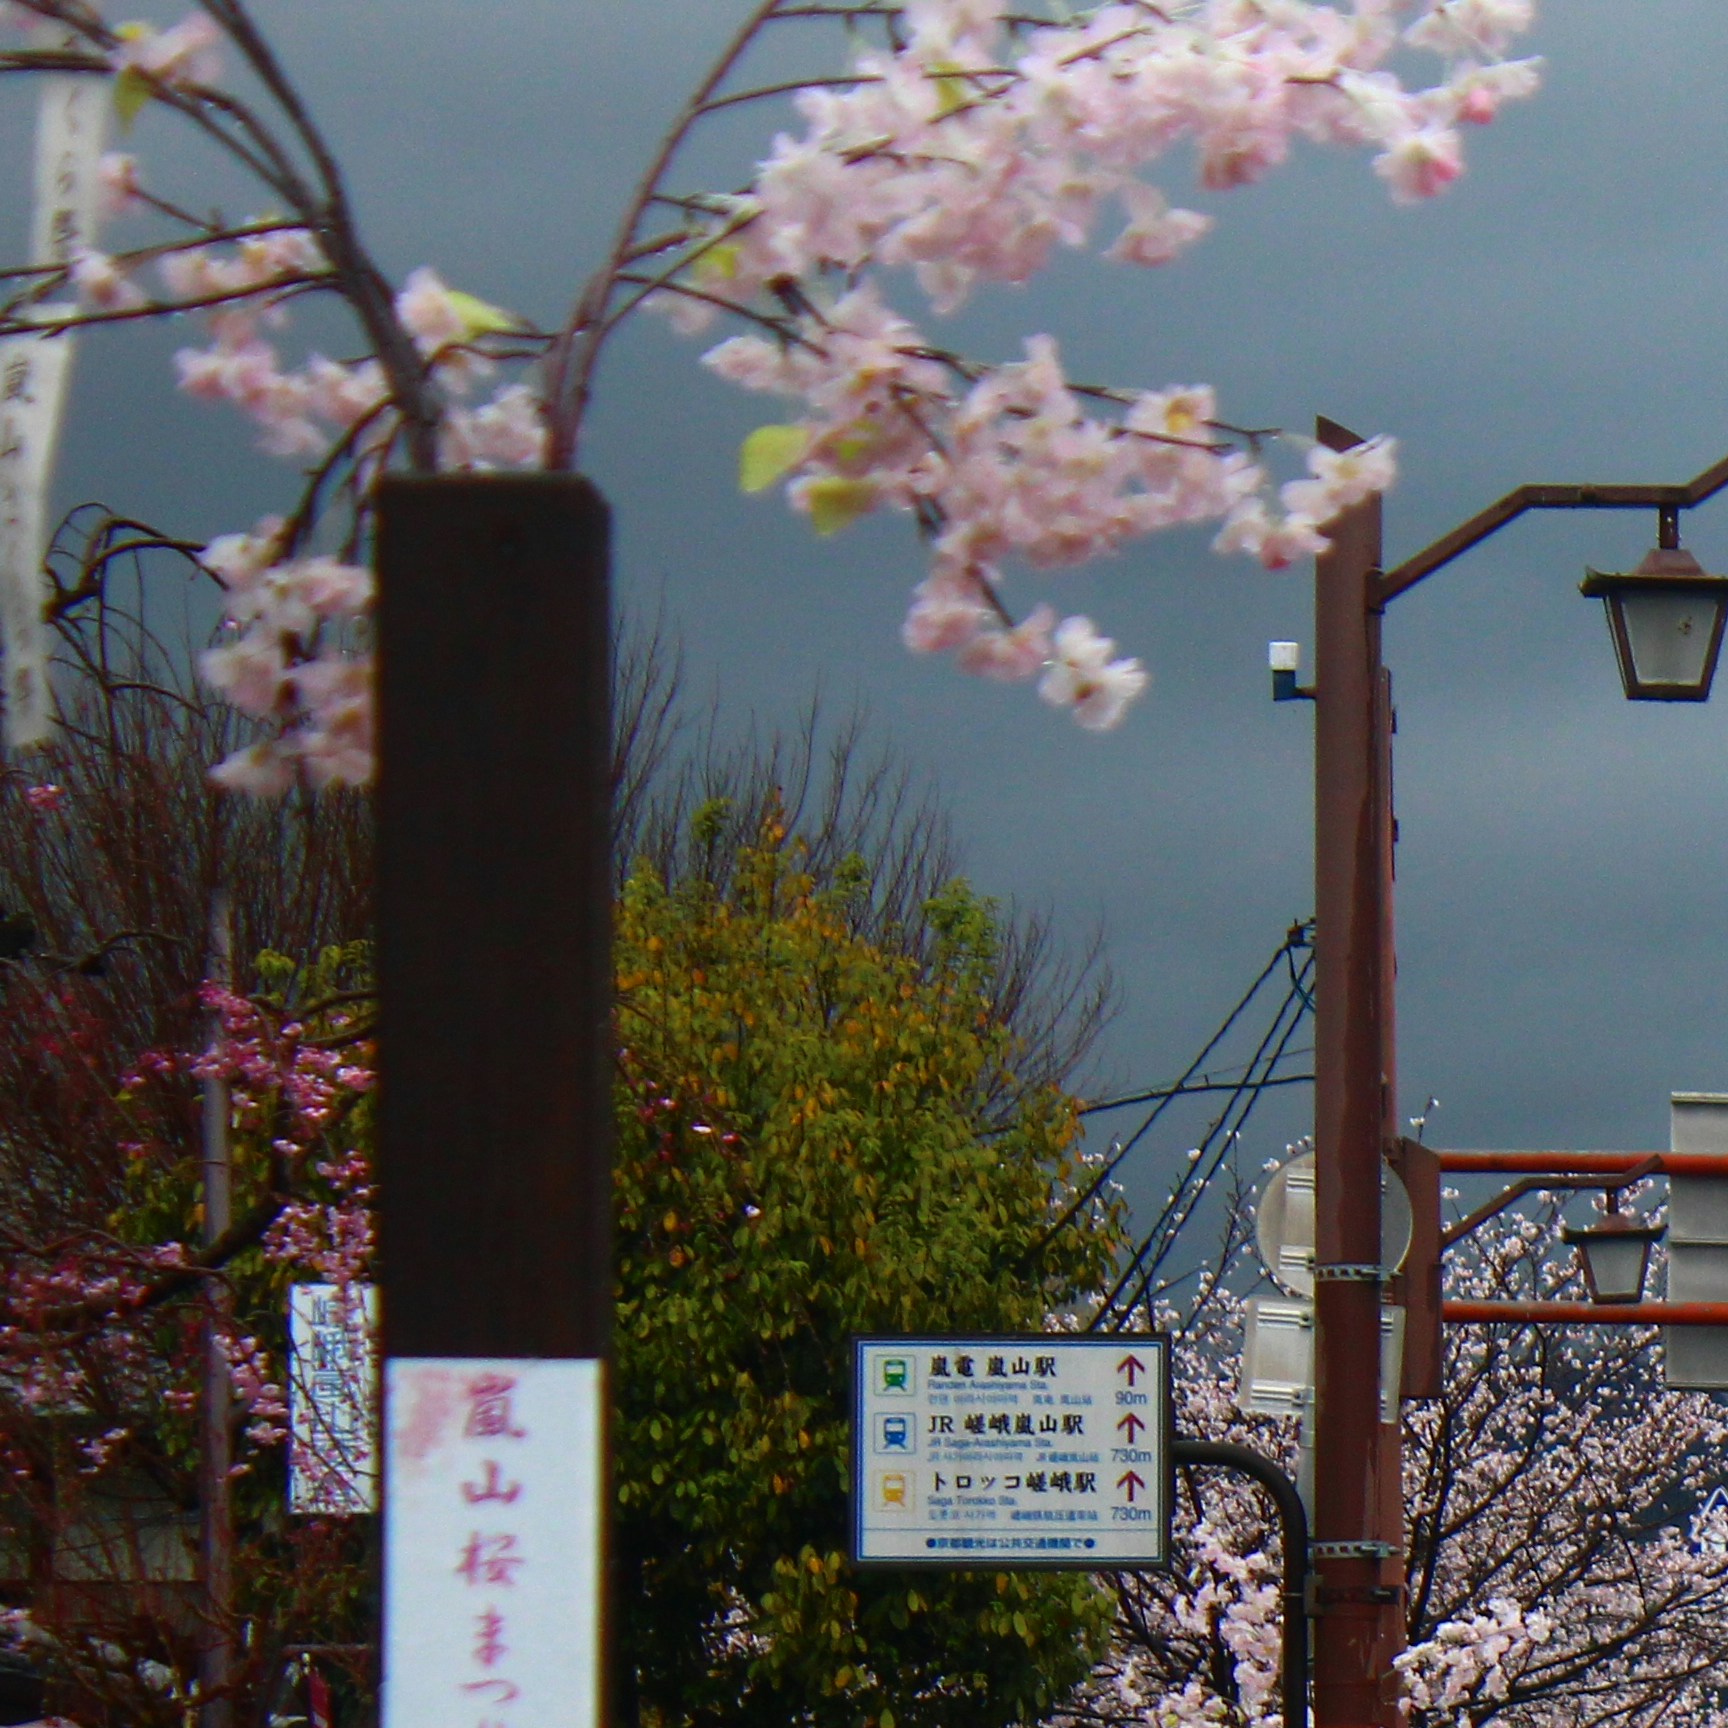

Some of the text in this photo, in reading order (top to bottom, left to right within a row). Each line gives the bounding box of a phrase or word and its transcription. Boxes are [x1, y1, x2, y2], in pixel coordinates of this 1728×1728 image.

[931, 1354, 1056, 1377] 嵐電 嵐山駅
[1115, 1391, 1148, 1406] 90m
[928, 1412, 1084, 1435] JR 嵯峨嵐山駅
[1111, 1449, 1152, 1464] 730m
[934, 1471, 1097, 1493] トロッコ嵯峨駅
[1111, 1507, 1152, 1521] 730m
